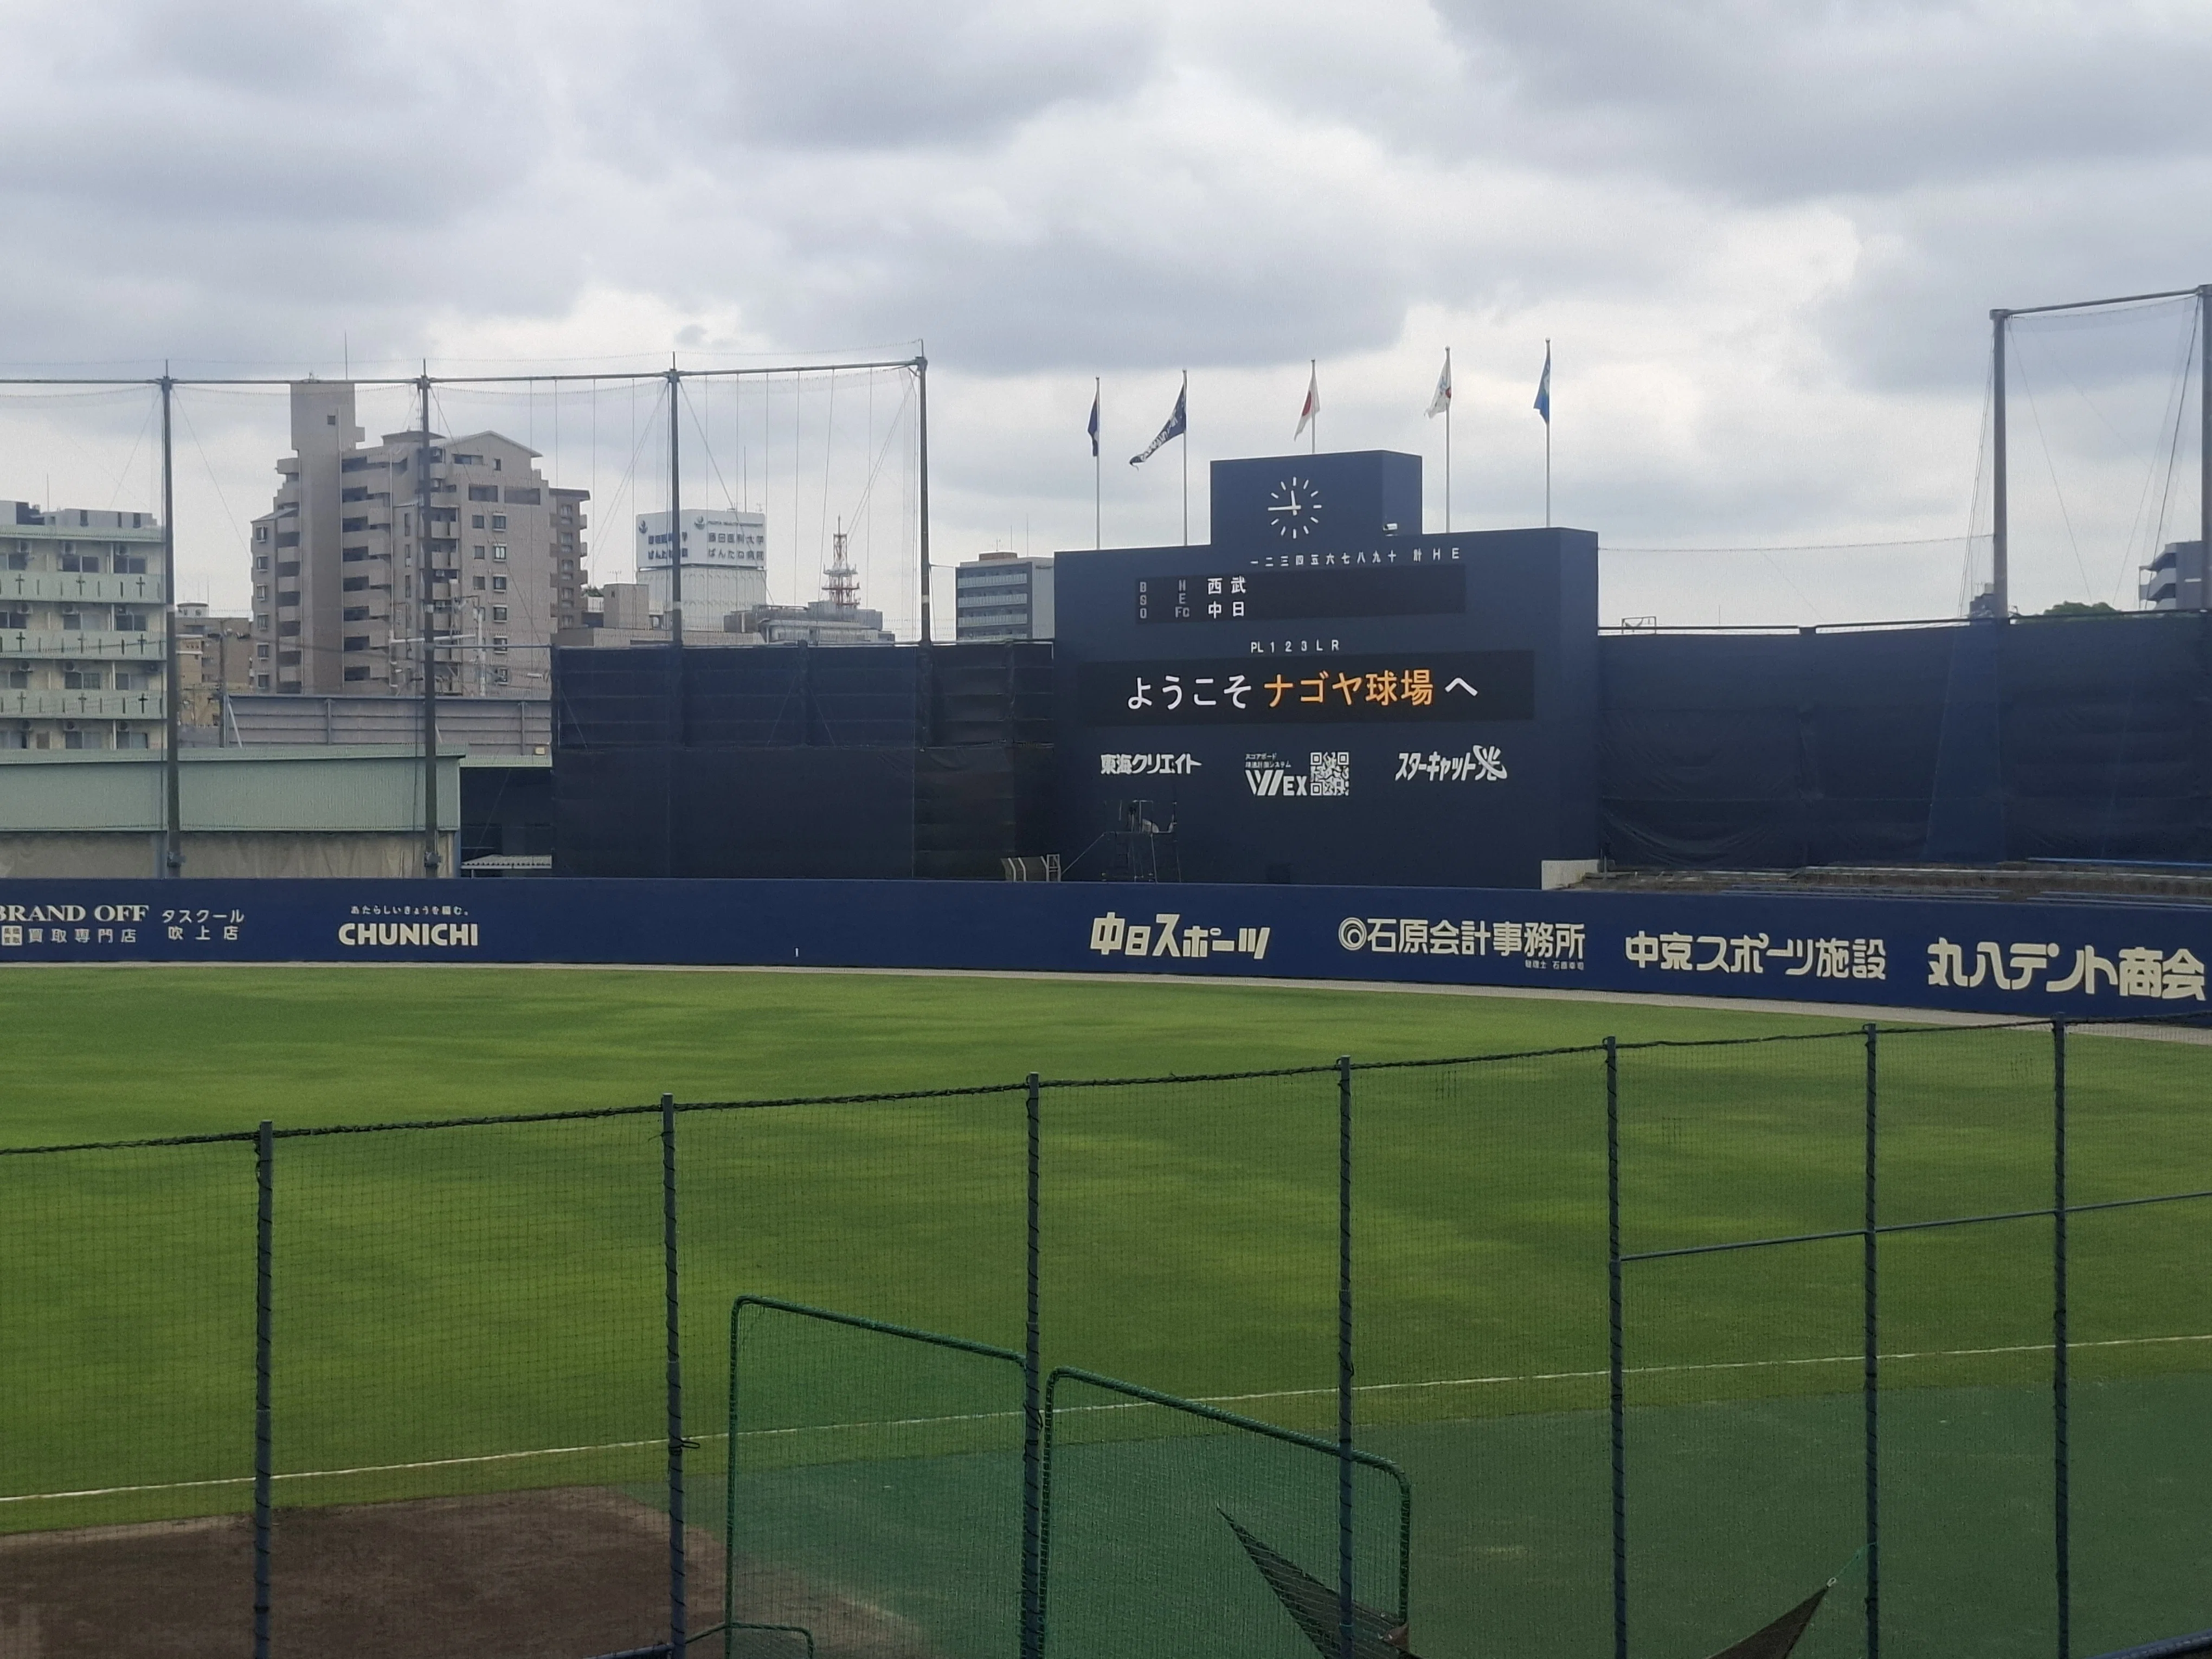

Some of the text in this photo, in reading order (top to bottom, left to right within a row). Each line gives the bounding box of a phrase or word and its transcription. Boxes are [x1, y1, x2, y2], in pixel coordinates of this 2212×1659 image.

[1433, 548, 1441, 561] H
[1452, 548, 1459, 560] E
[1207, 575, 1246, 595] 西武
[1179, 593, 1186, 604] E
[1208, 601, 1245, 619] 中日
[1251, 642, 1264, 653] PL
[1270, 642, 1275, 652] 1
[1285, 641, 1293, 652] 2
[1316, 640, 1323, 651] L
[1332, 639, 1339, 651] R
[1128, 670, 1478, 710] ようこそ ナゴヤ球場 へ
[1101, 754, 1202, 774] 東海クリエイト
[1394, 744, 1508, 781] スターキャット光
[0, 905, 150, 922] BRAND OFF
[162, 909, 245, 923] タスクール
[168, 925, 239, 941] 吹上店
[338, 923, 478, 946] CHUNICHI
[1090, 911, 1271, 960] 中日スポーツ
[1367, 918, 1585, 960] 石原会計事務所
[1625, 930, 1887, 980] 中京スポーツ施設
